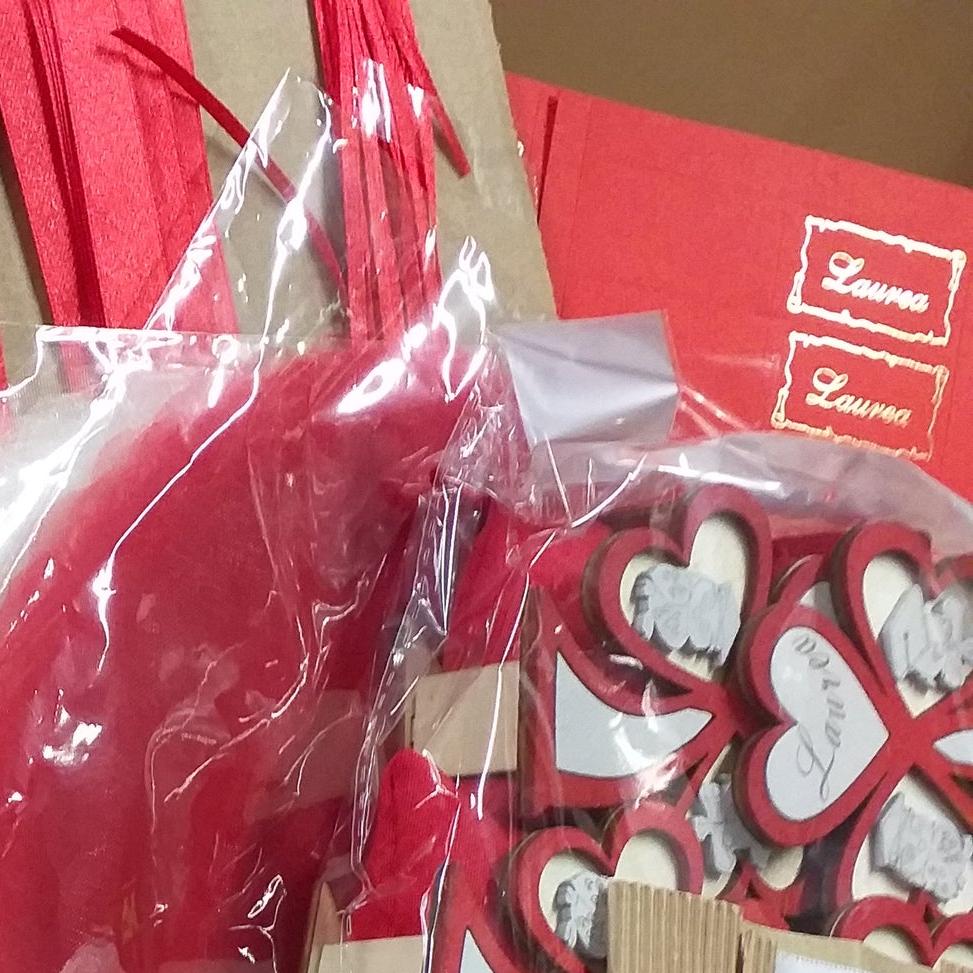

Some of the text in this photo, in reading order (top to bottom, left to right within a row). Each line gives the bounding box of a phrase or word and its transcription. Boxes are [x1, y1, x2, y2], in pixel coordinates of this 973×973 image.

[821, 252, 930, 313] Laurea
[806, 367, 913, 428] Laurea
[792, 635, 847, 801] Laurea
